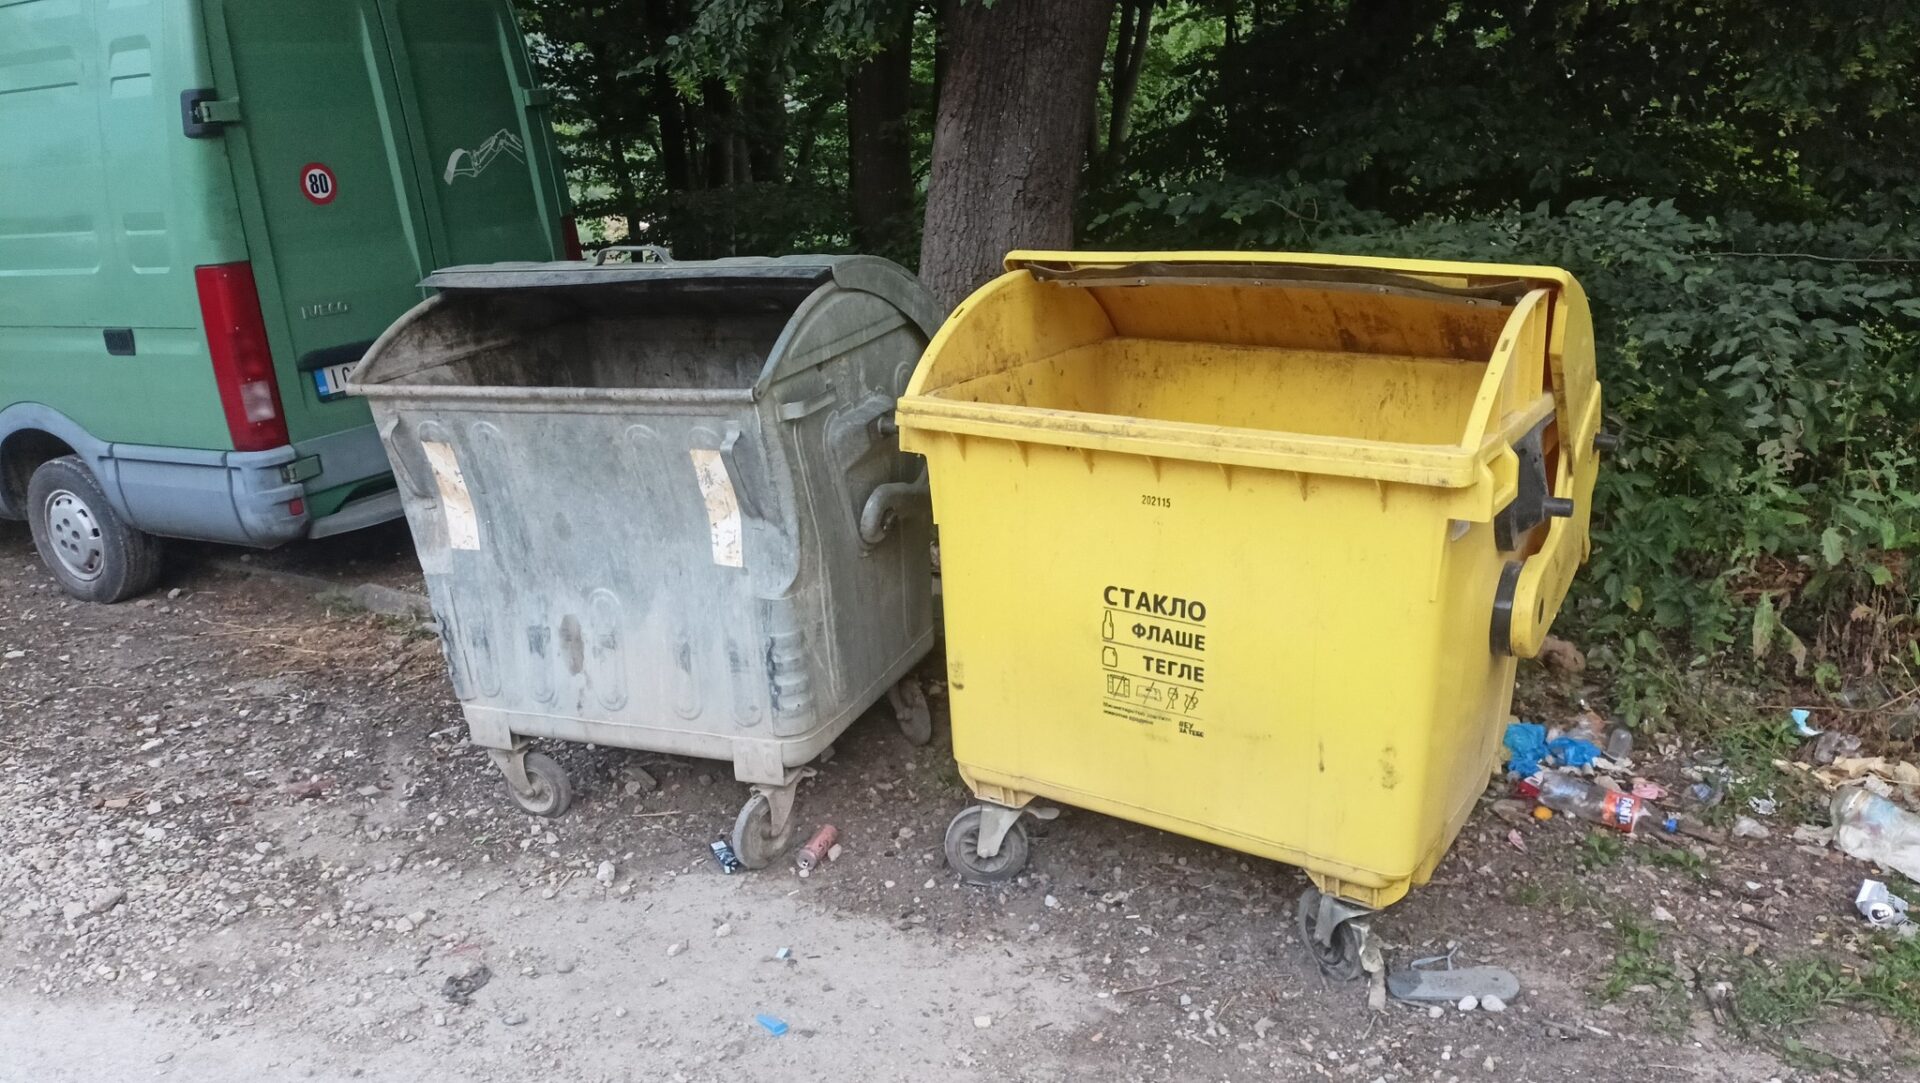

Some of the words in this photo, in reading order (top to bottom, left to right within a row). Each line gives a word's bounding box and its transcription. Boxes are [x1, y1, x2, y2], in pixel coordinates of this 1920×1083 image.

[308, 173, 329, 194] 80
[301, 301, 349, 320] IVECO
[1141, 494, 1171, 508] 202115
[1103, 585, 1206, 622] СТАКЛО
[1131, 623, 1205, 651] ФЛАШЕ
[1142, 655, 1205, 683] ТЕГЛЕ
